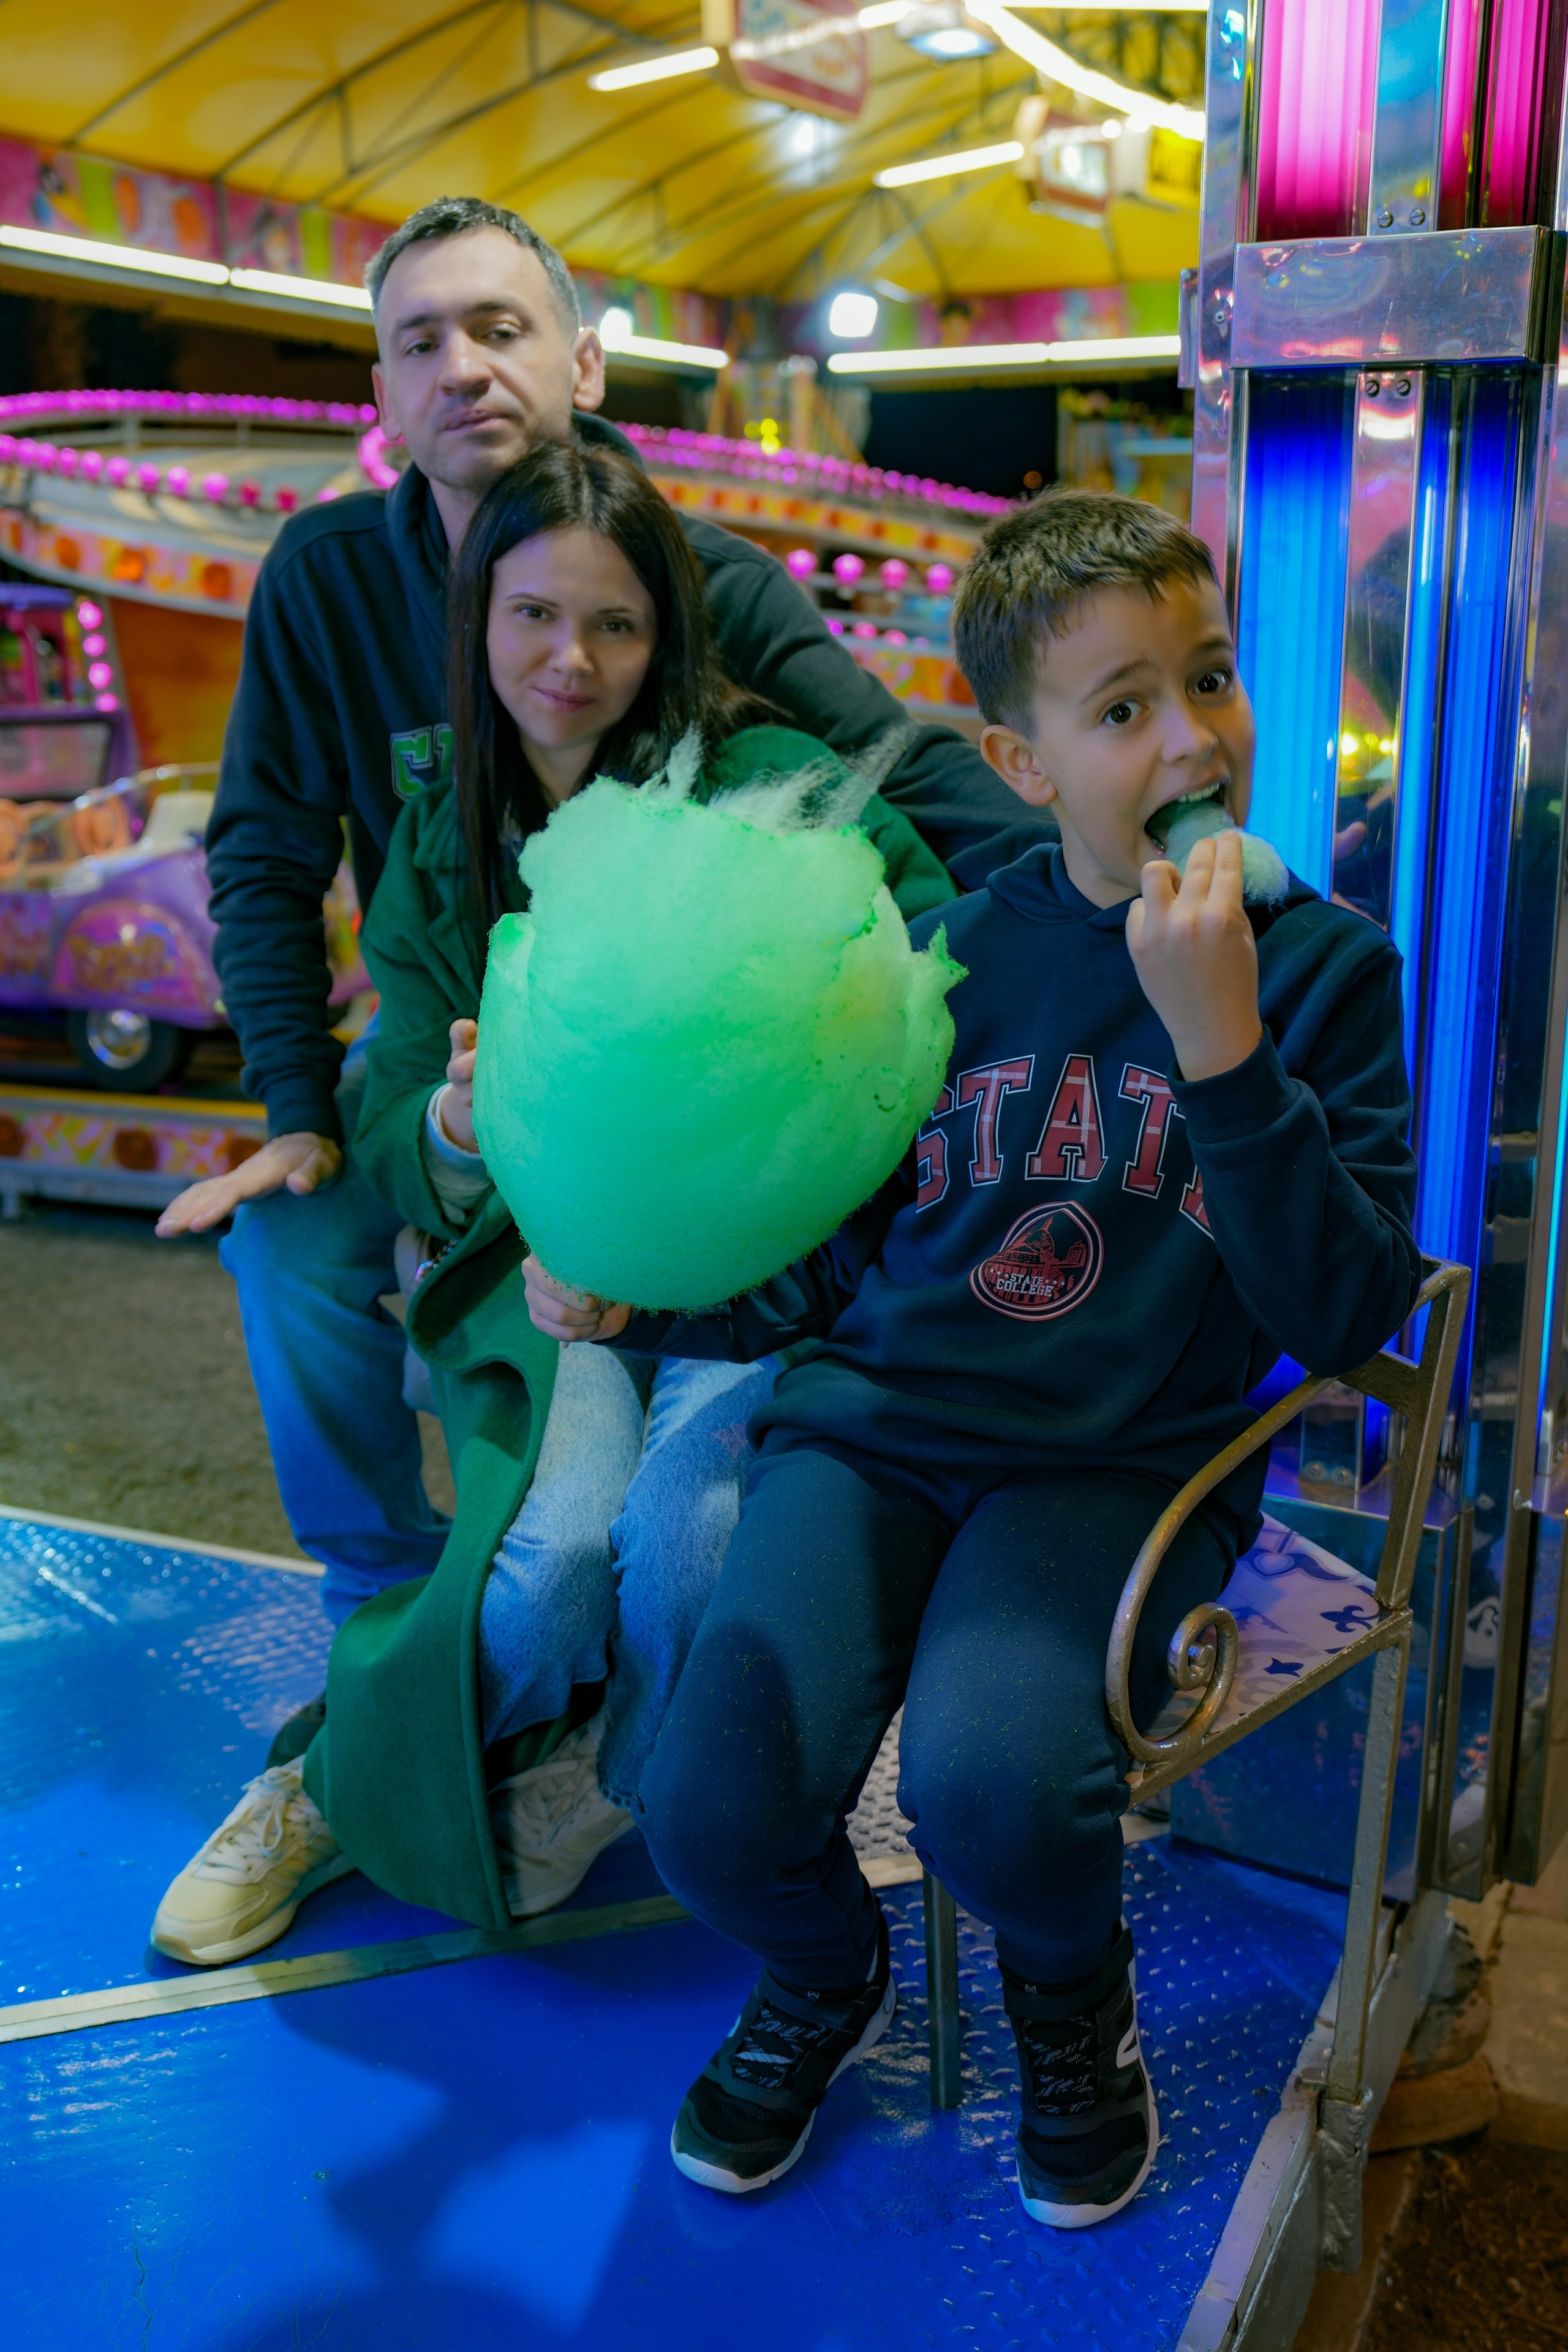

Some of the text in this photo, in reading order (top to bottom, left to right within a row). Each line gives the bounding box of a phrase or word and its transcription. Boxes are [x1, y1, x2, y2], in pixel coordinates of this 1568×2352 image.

[916, 1054, 1215, 1242] STAT
[996, 1278, 1054, 1297] COLLEGE
[1009, 1273, 1045, 1285] STATE
